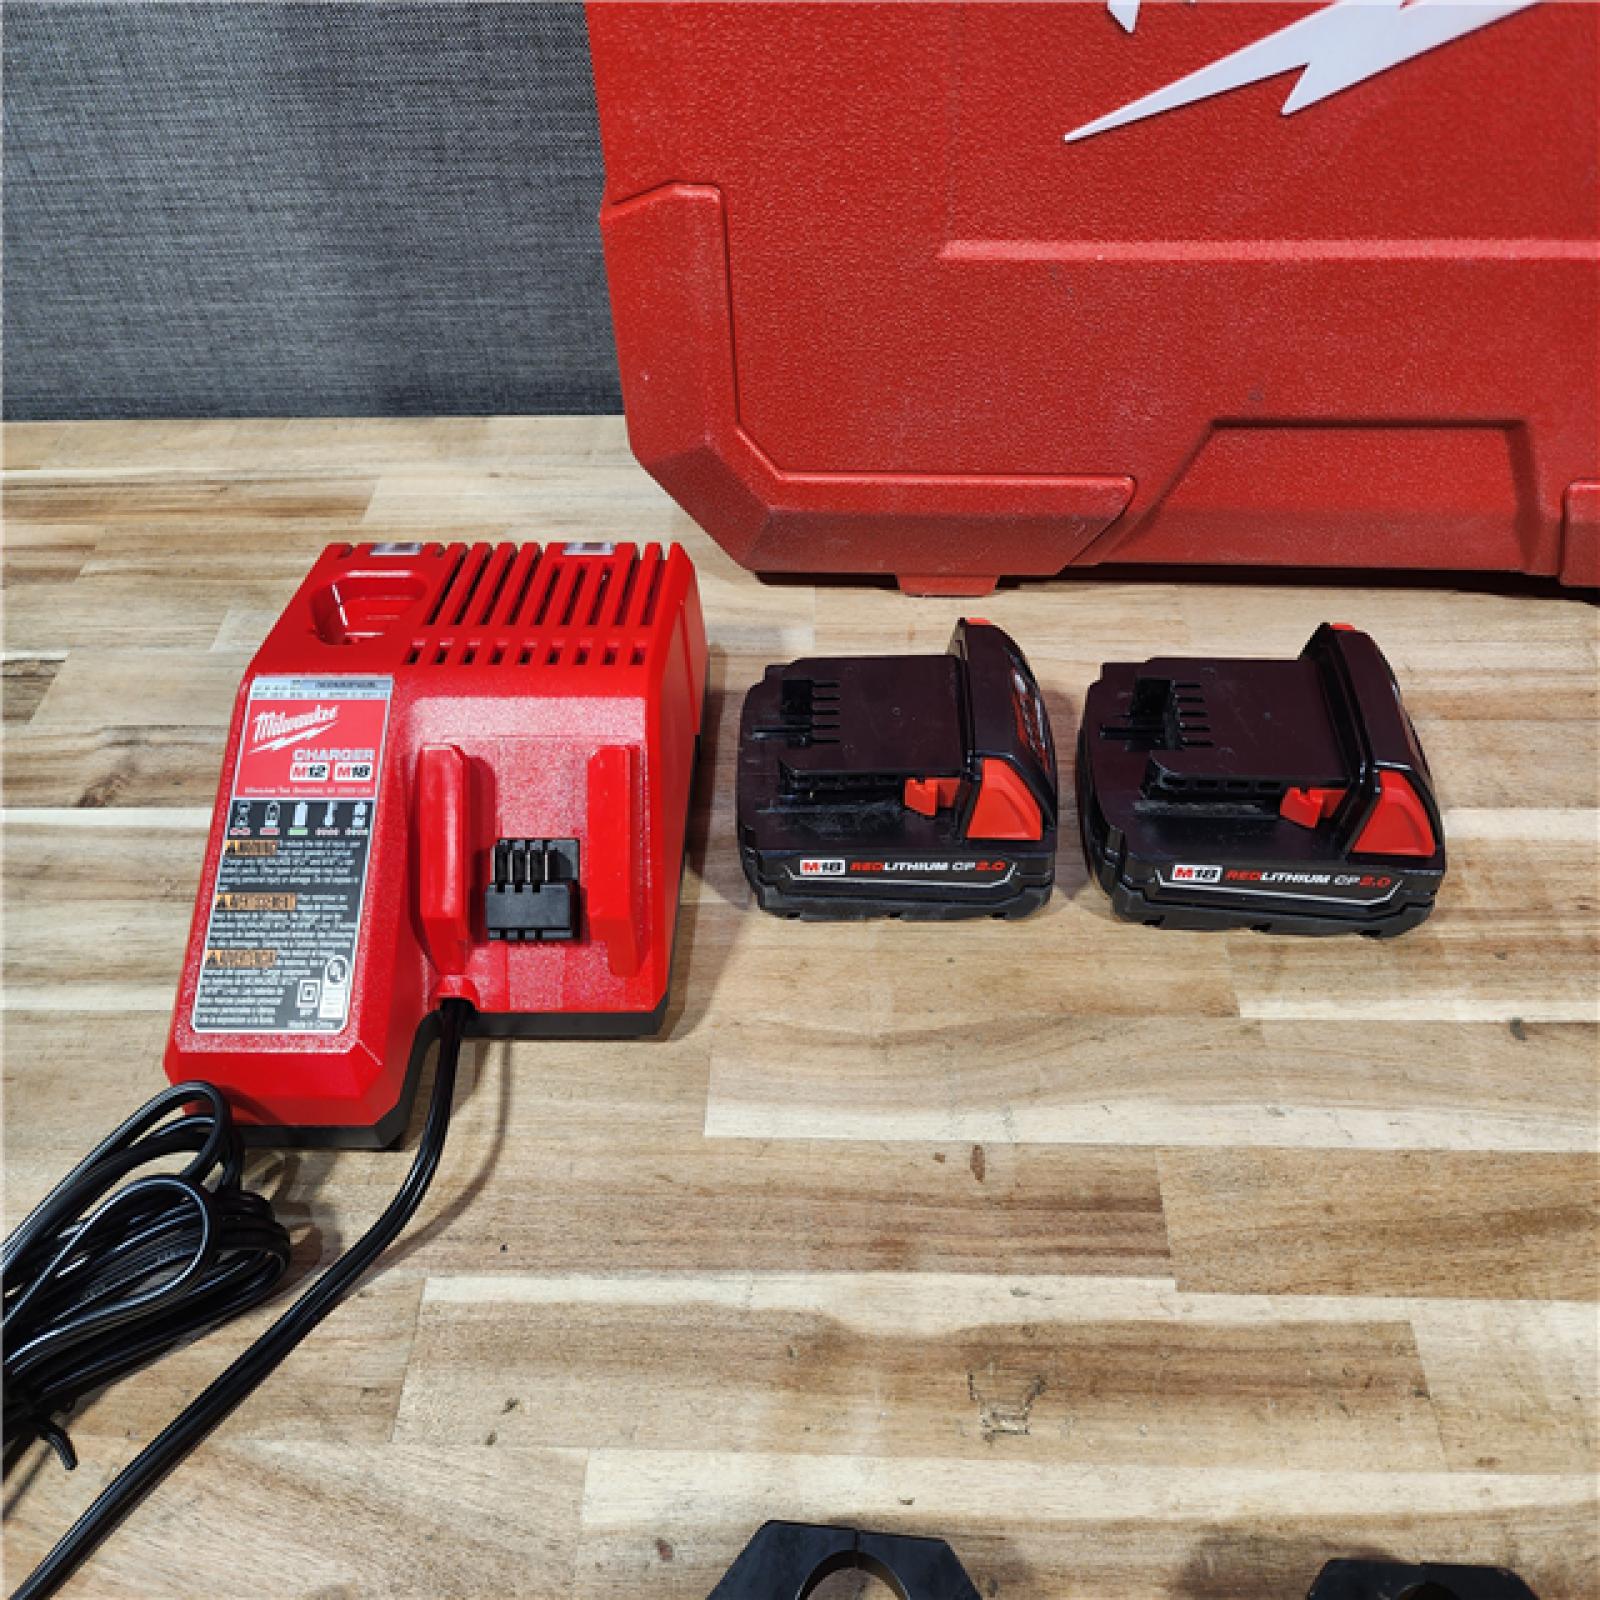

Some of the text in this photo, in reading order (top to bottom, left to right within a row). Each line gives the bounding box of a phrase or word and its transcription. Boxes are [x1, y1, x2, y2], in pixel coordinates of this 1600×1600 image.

[291, 749, 376, 761] CHARGER
[801, 861, 843, 874] M18
[849, 860, 949, 872] REDLITHIUM
[1174, 866, 1219, 881] M18
[1225, 869, 1331, 884] REDLITHIUM
